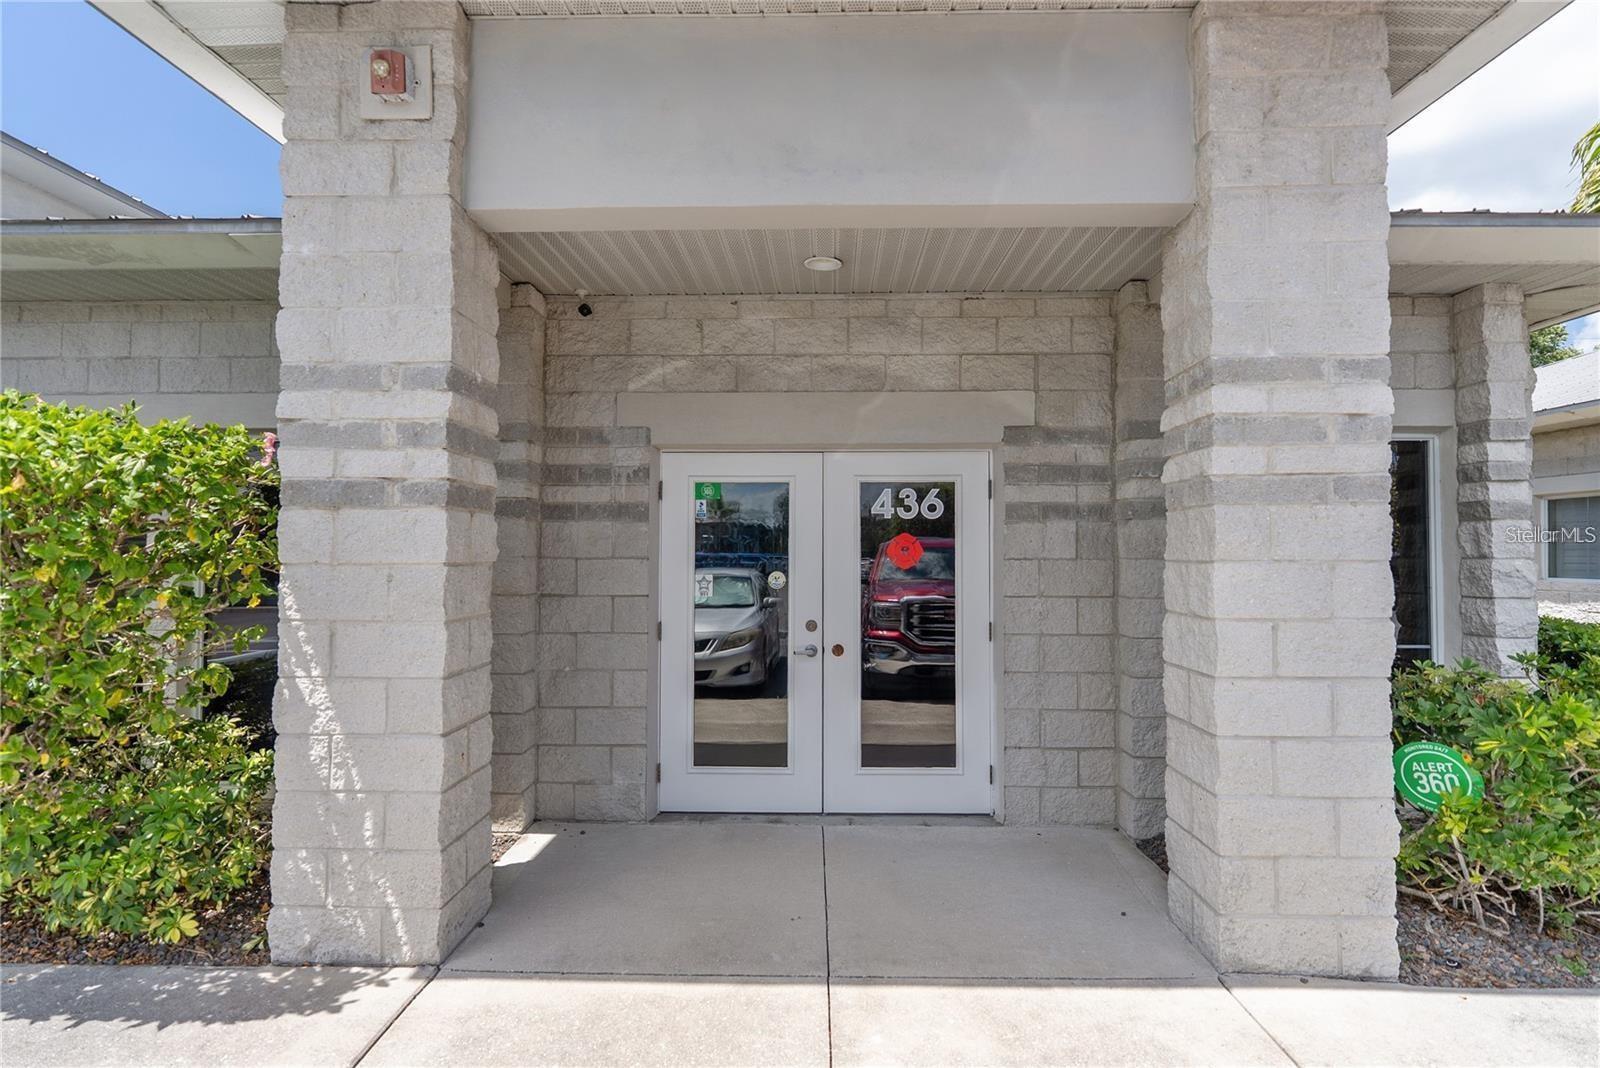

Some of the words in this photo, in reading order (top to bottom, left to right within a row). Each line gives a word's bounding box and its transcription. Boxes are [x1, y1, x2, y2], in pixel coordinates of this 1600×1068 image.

[871, 488, 945, 520] 436
[1412, 762, 1453, 773] ALERT
[1413, 772, 1460, 795] 360
